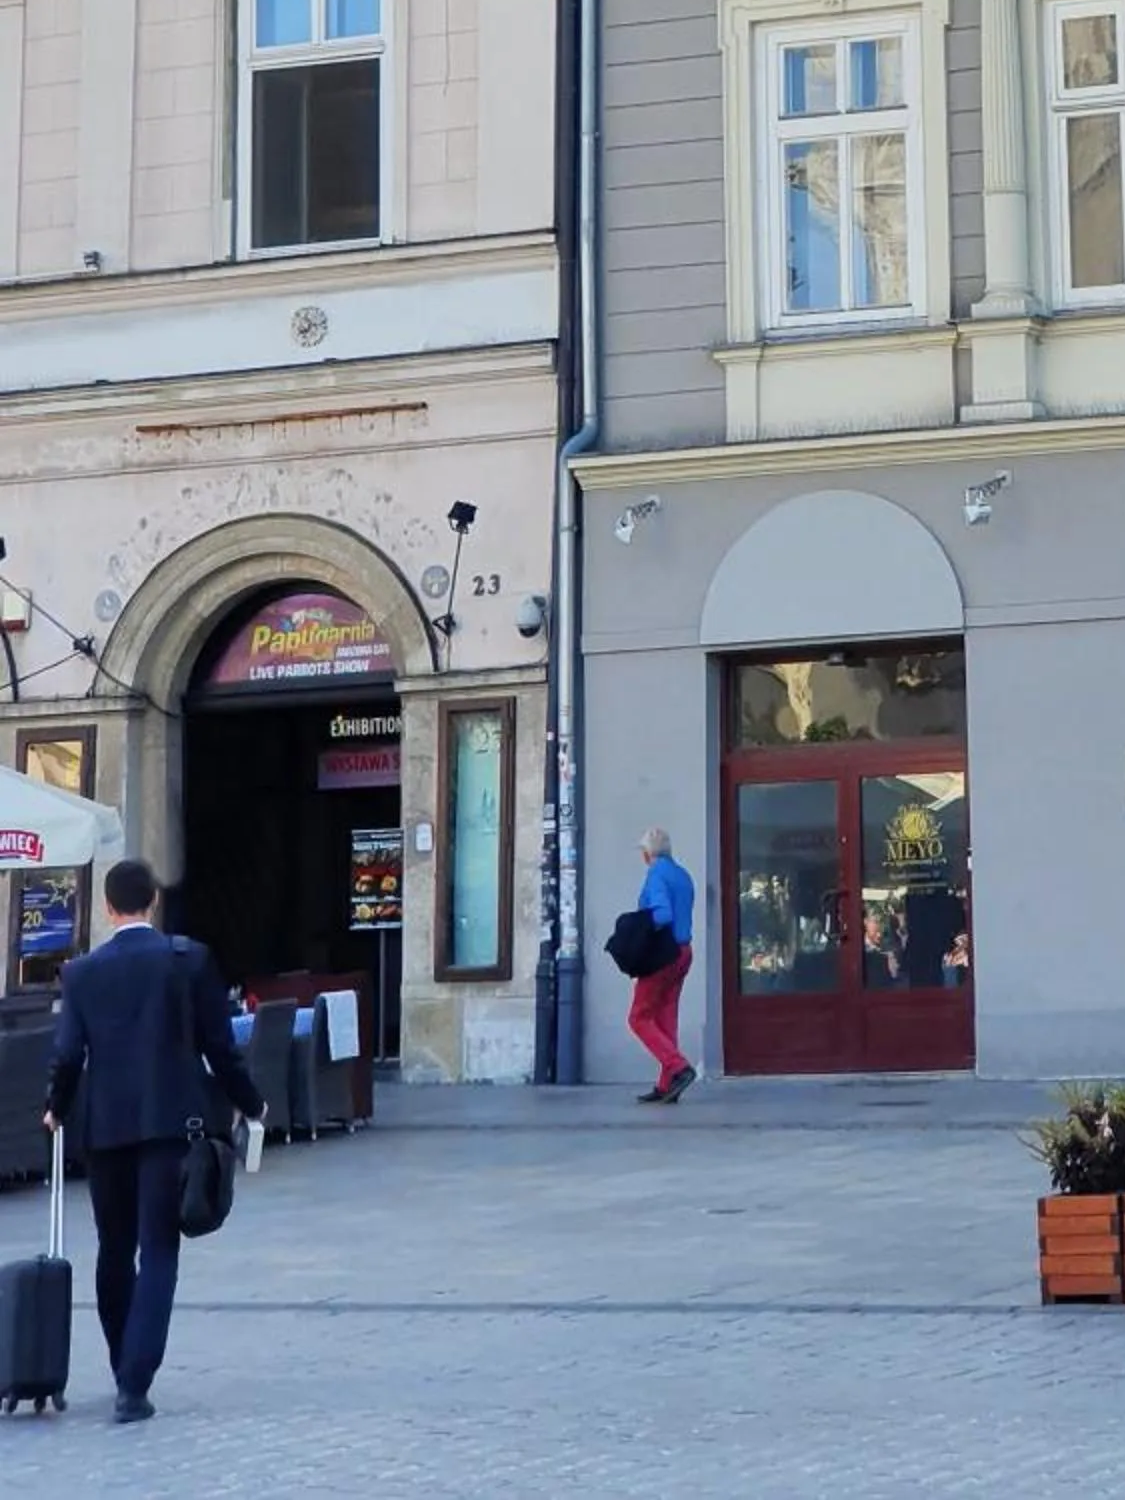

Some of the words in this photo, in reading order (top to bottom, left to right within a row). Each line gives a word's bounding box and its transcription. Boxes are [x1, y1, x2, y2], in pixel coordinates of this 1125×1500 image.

[472, 574, 501, 597] 23
[250, 665, 275, 680] LIVE
[333, 659, 370, 674] SHOW
[22, 911, 42, 928] 20
